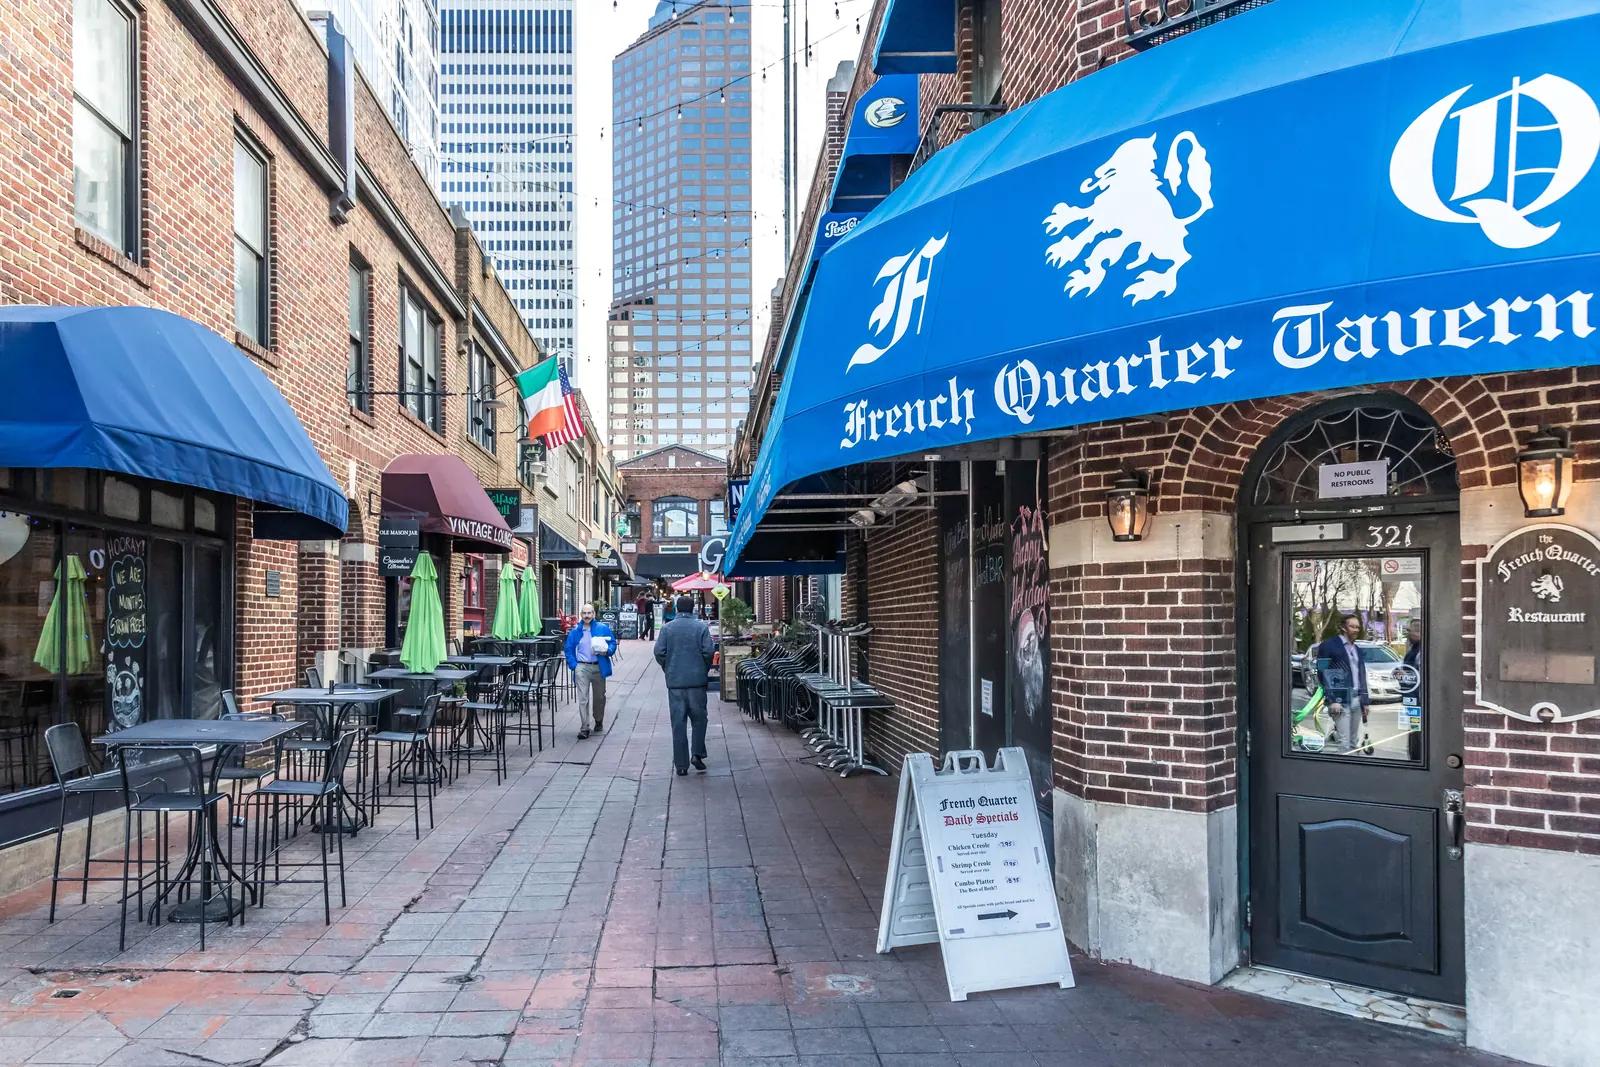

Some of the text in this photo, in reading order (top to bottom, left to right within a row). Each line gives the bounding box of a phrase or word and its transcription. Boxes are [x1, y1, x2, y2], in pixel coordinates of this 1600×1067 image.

[1389, 73, 1600, 249] Q
[840, 290, 1597, 450] French Quarter Tavern
[1346, 469, 1371, 477] PUBLIC
[1331, 479, 1374, 488] RESTROOMS
[490, 493, 518, 505] elfast
[449, 517, 493, 540] VINTAGE
[1366, 524, 1413, 548] 321
[1539, 534, 1553, 544] the
[1497, 544, 1600, 583] French Quarter
[129, 566, 141, 583] ARE
[1507, 607, 1586, 623] Restaurant
[939, 795, 1017, 811] French Quarter
[943, 811, 1019, 827] Daily Specials
[971, 832, 998, 840] Tuesday
